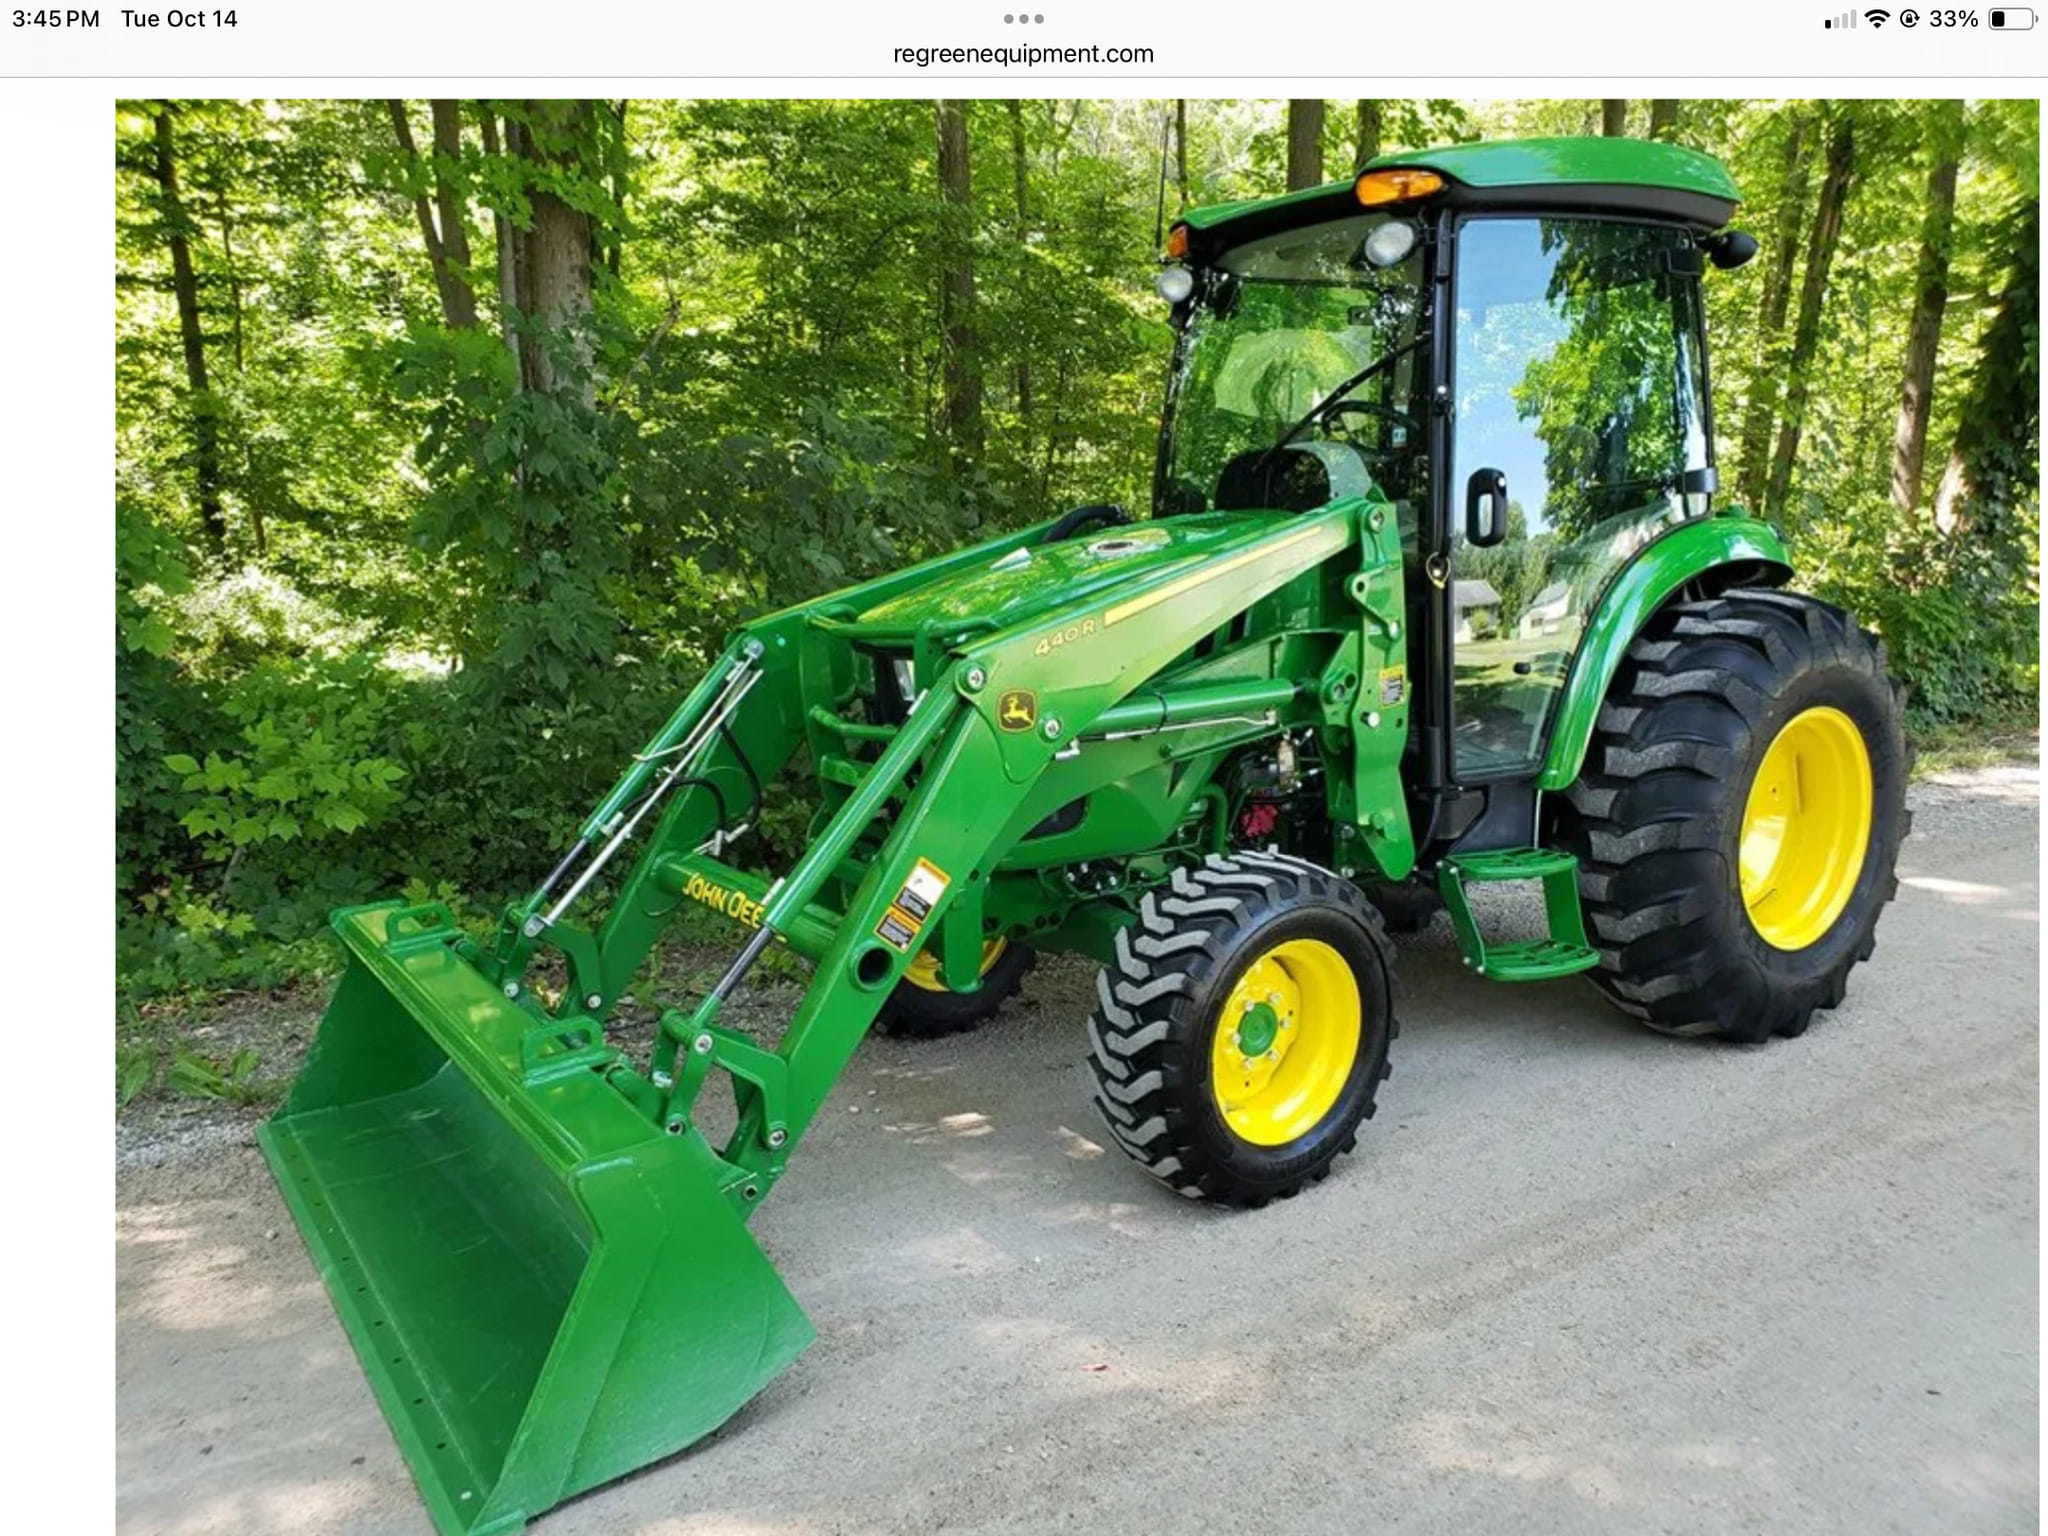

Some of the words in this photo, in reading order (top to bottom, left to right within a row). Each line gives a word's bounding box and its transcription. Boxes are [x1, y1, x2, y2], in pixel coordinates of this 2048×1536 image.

[12, 10, 62, 28] 3:45
[66, 10, 100, 28] PM
[121, 10, 160, 28] Tue
[167, 10, 206, 28] Oct
[212, 10, 238, 28] 14
[1929, 9, 1979, 28] 33%
[894, 43, 1155, 67] regreenequipment.com
[682, 872, 729, 913] JOHN
